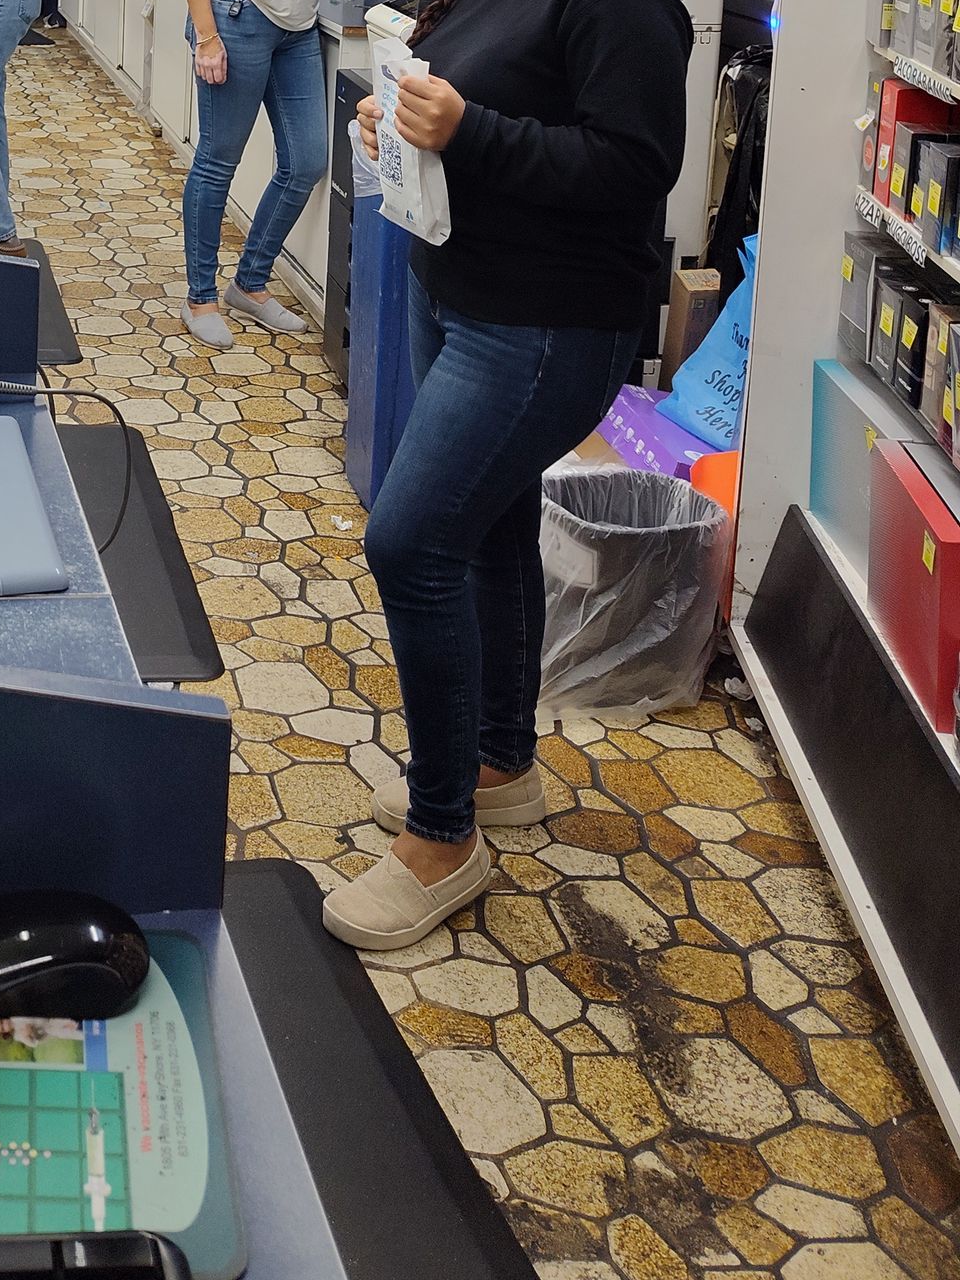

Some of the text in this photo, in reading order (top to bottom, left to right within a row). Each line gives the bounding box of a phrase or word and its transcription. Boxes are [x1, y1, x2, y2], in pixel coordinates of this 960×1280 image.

[894, 56, 913, 80] PACO
[906, 234, 926, 267] BOSS
[696, 406, 733, 439] Here
